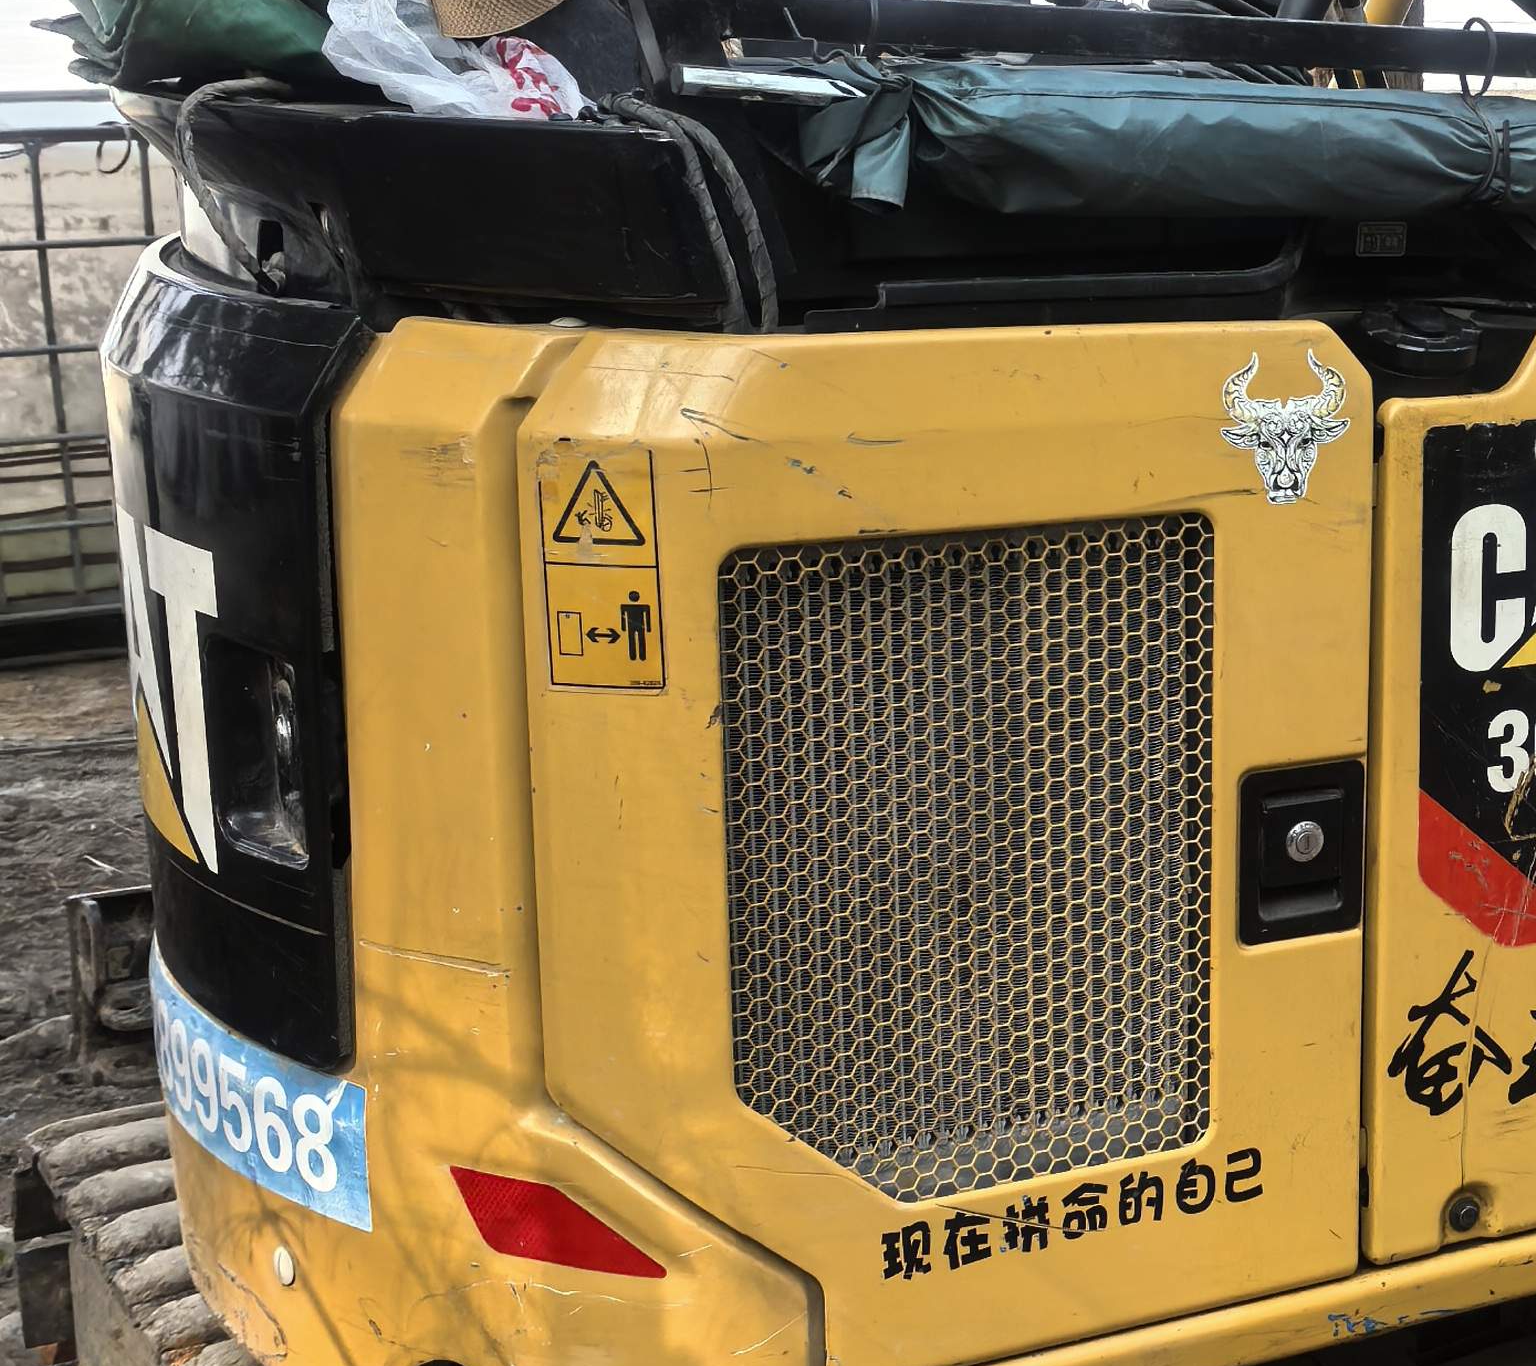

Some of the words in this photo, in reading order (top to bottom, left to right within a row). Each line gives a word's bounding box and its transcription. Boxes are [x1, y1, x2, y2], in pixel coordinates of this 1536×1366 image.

[880, 1147, 1264, 1281] 现在拼命的自己
